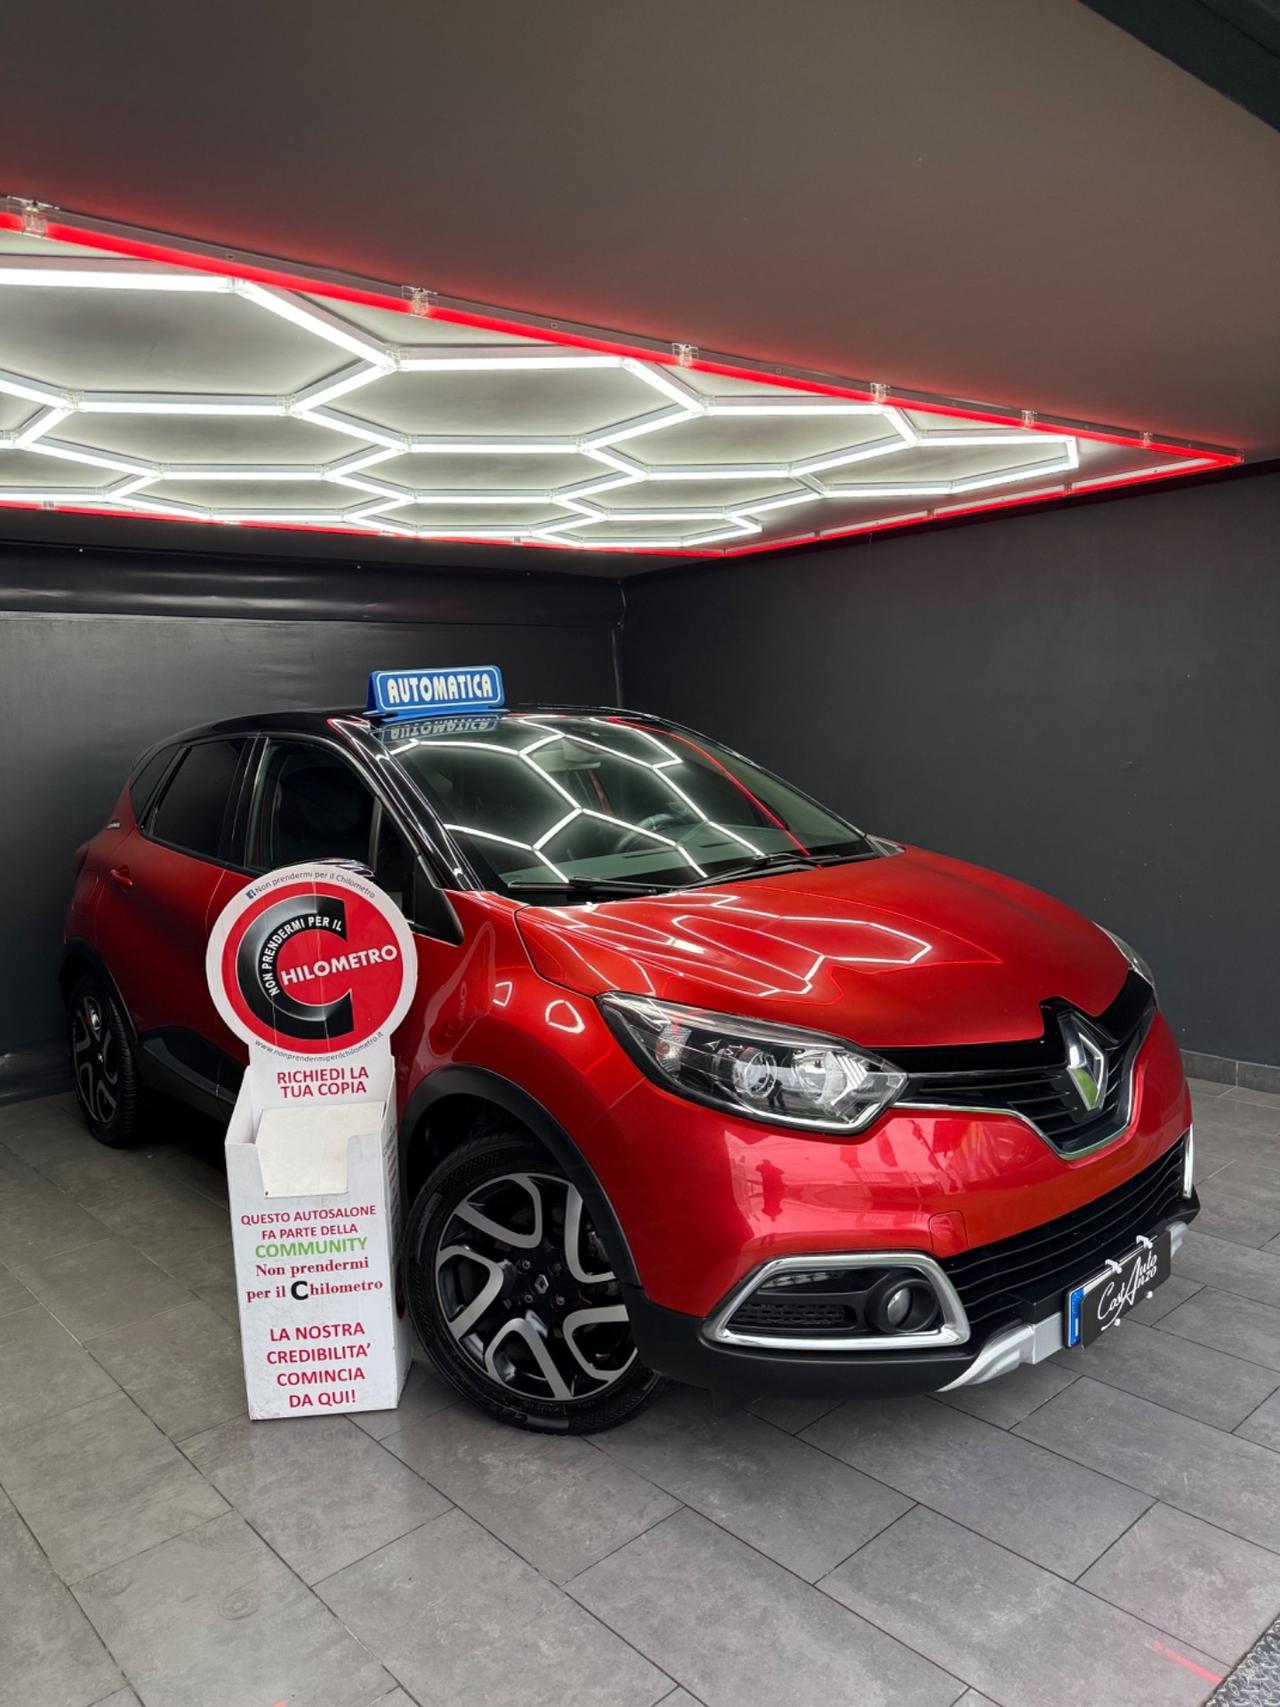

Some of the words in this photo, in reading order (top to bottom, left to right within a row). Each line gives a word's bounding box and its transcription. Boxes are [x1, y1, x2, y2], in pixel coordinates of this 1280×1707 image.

[387, 673, 493, 704] AUTOMATICA
[255, 882, 271, 894] Non
[271, 872, 312, 886] prendermi
[315, 871, 328, 880] per
[336, 874, 376, 899] Chilometro
[308, 916, 330, 928] PER
[332, 919, 342, 932] IL
[262, 918, 305, 969] PRENDERMI
[262, 969, 280, 996] NON
[277, 1068, 345, 1085] RICHIEDI
[350, 1066, 369, 1080] LA
[280, 1085, 313, 1099] TUA
[318, 1081, 367, 1096] COPIA
[241, 1211, 290, 1226] QUESTO
[294, 1205, 376, 1222] AUTOSALONE
[262, 1229, 277, 1240] FA
[279, 1227, 317, 1239] PARTE
[321, 1223, 358, 1236] DELLA
[255, 1236, 368, 1259] COMMUNITY
[256, 1263, 285, 1277] Non
[290, 1257, 369, 1278] prendermi
[246, 1288, 271, 1303] per
[275, 1285, 286, 1298] il
[290, 1280, 383, 1301] Chilometro
[270, 1328, 291, 1342] LA
[295, 1322, 365, 1341] NOSTRA
[276, 1367, 365, 1387] COMINCIA
[289, 1394, 313, 1408] DA
[317, 1388, 356, 1408] QUI!
